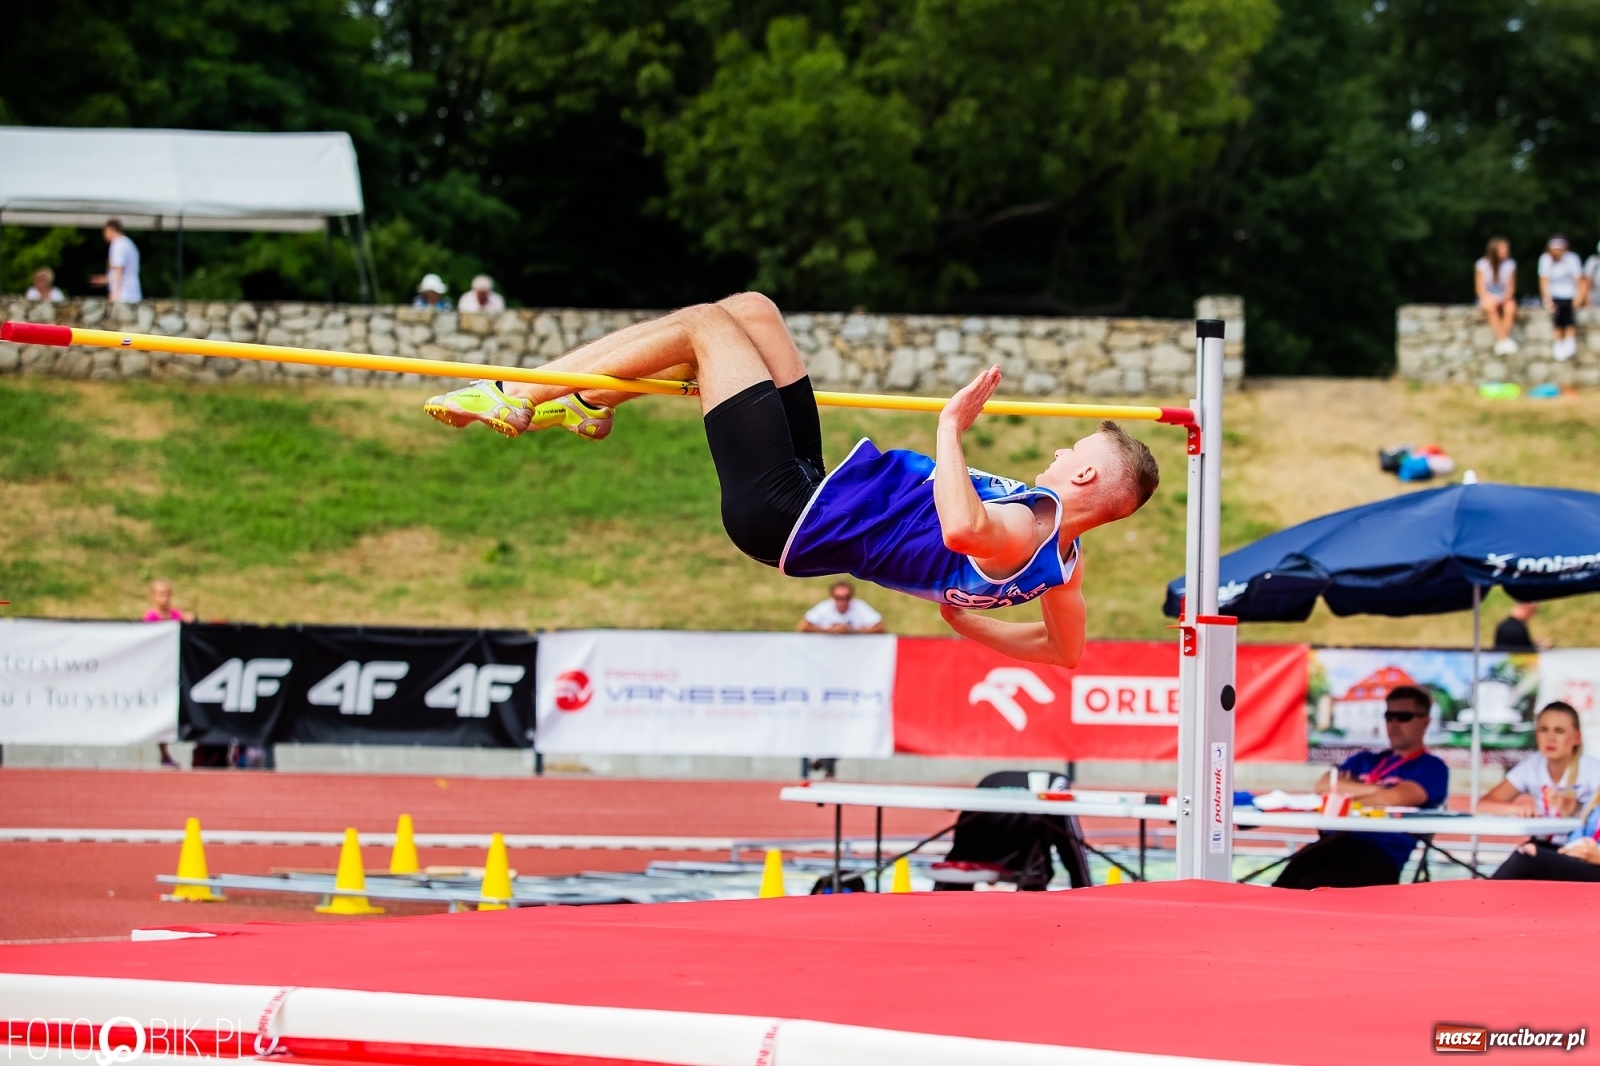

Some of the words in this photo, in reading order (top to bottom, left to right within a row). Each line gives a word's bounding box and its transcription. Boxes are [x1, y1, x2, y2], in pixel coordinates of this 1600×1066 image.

[45, 686, 159, 714] Turystyki
[190, 657, 293, 712] 4F
[307, 660, 410, 715] 4F
[424, 663, 526, 718] 4F
[604, 684, 810, 705] VANESSA
[823, 687, 884, 706] FM
[1213, 767, 1223, 824] polanik
